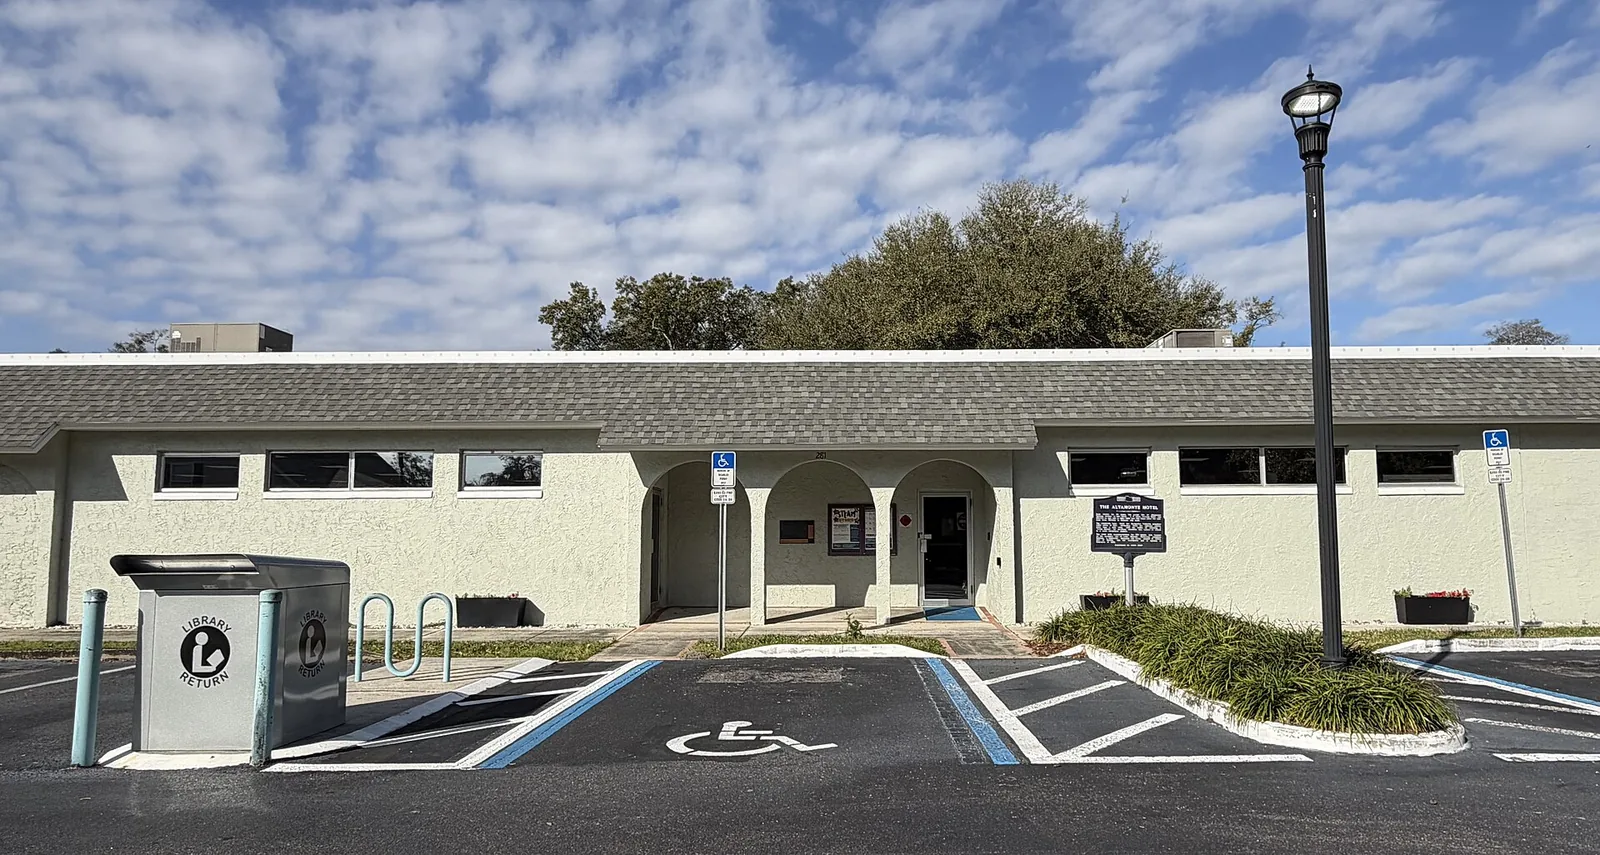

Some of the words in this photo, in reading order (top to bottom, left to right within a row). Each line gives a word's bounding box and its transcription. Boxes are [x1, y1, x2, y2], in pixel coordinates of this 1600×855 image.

[182, 615, 232, 633] LIBRARY
[299, 610, 328, 628] LIBRARY
[298, 660, 326, 678] RETURN
[179, 671, 229, 689] RETURN
